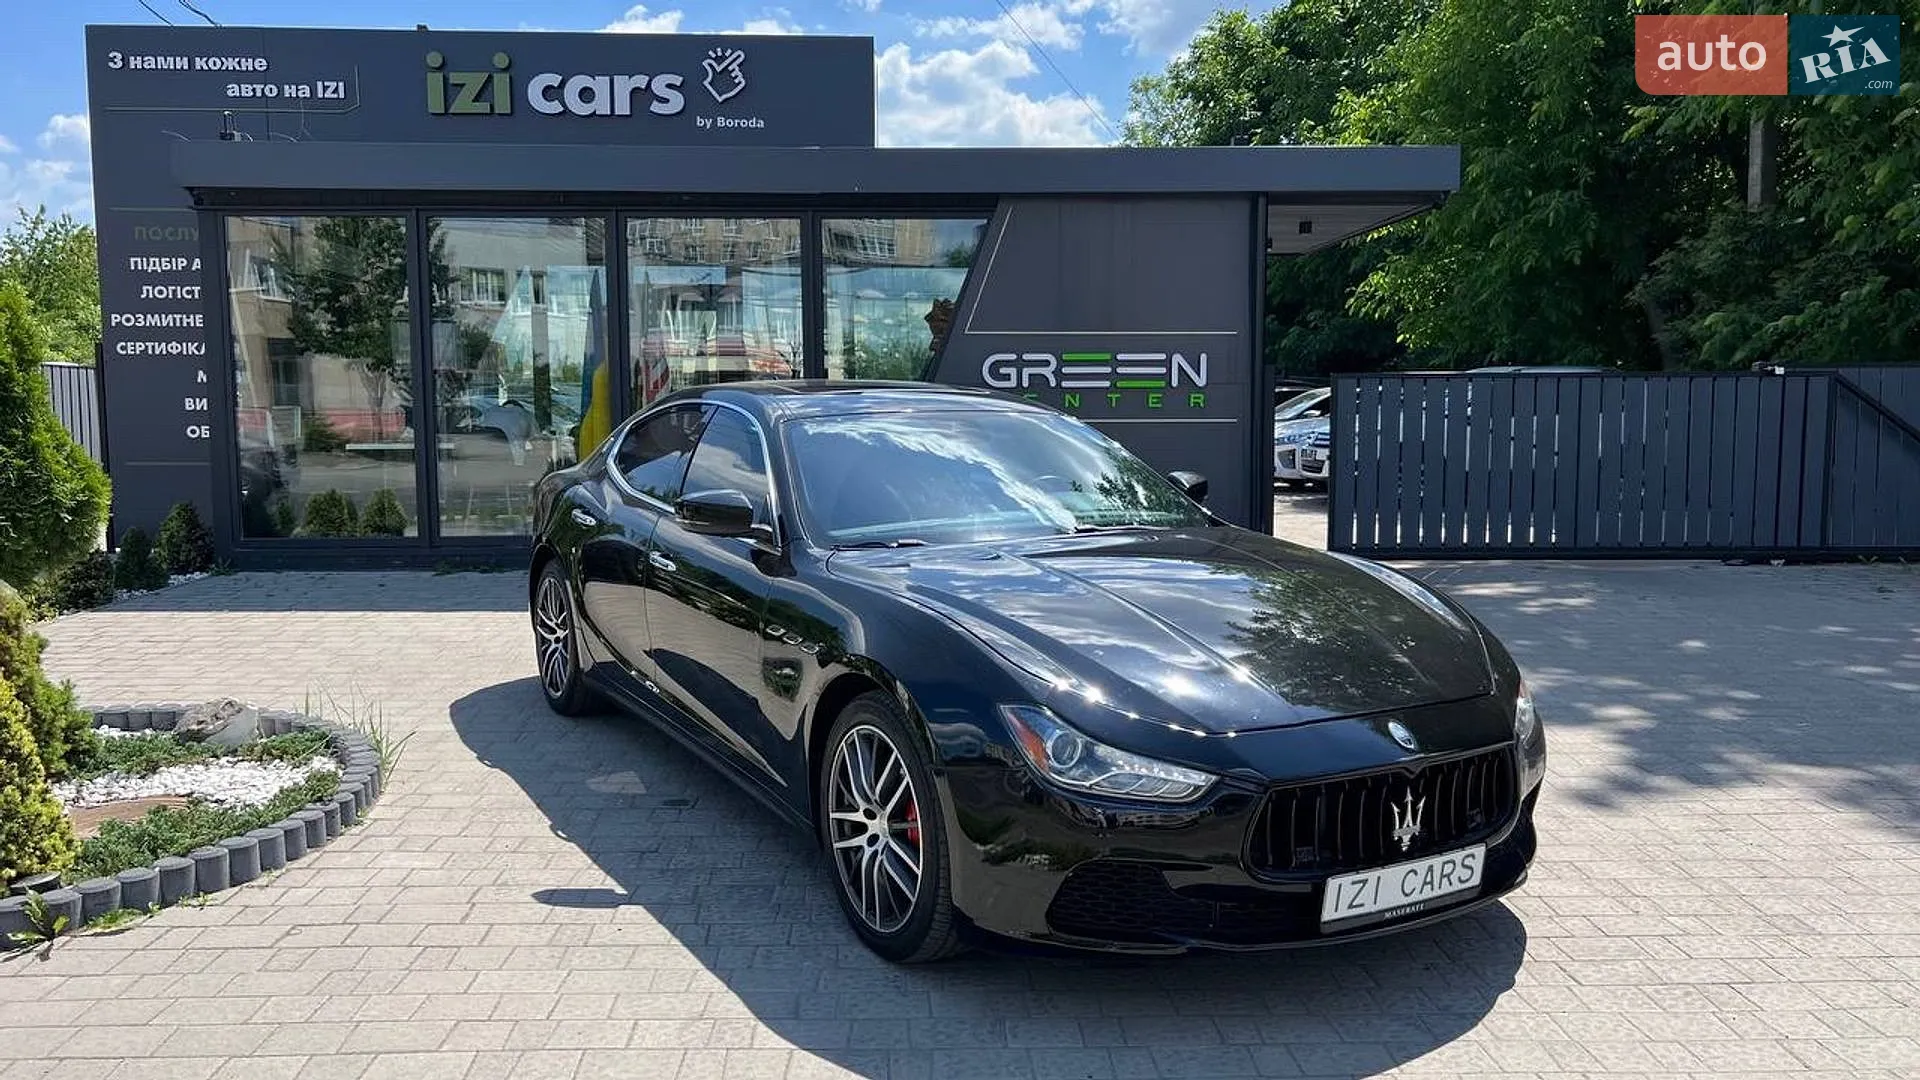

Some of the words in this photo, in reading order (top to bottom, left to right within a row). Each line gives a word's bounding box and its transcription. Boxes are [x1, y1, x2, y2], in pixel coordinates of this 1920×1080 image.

[108, 52, 123, 69] З
[129, 56, 189, 70] нами
[195, 57, 269, 71] кожне
[226, 83, 279, 98] авто
[284, 84, 311, 98] на
[316, 81, 345, 99] IZI
[426, 51, 512, 115] izi
[527, 73, 686, 116] cars
[696, 115, 713, 129] by
[717, 116, 765, 129] Boroda
[130, 257, 188, 273] ПІДБІР
[140, 285, 201, 299] ЛОГІСТ
[111, 313, 204, 327] РОЗМИТНЕ
[982, 353, 1207, 388] GREEN
[184, 397, 209, 411] ВИ
[187, 425, 210, 438] ОБ
[1334, 876, 1381, 913] IZI
[1401, 853, 1476, 897] CARS
